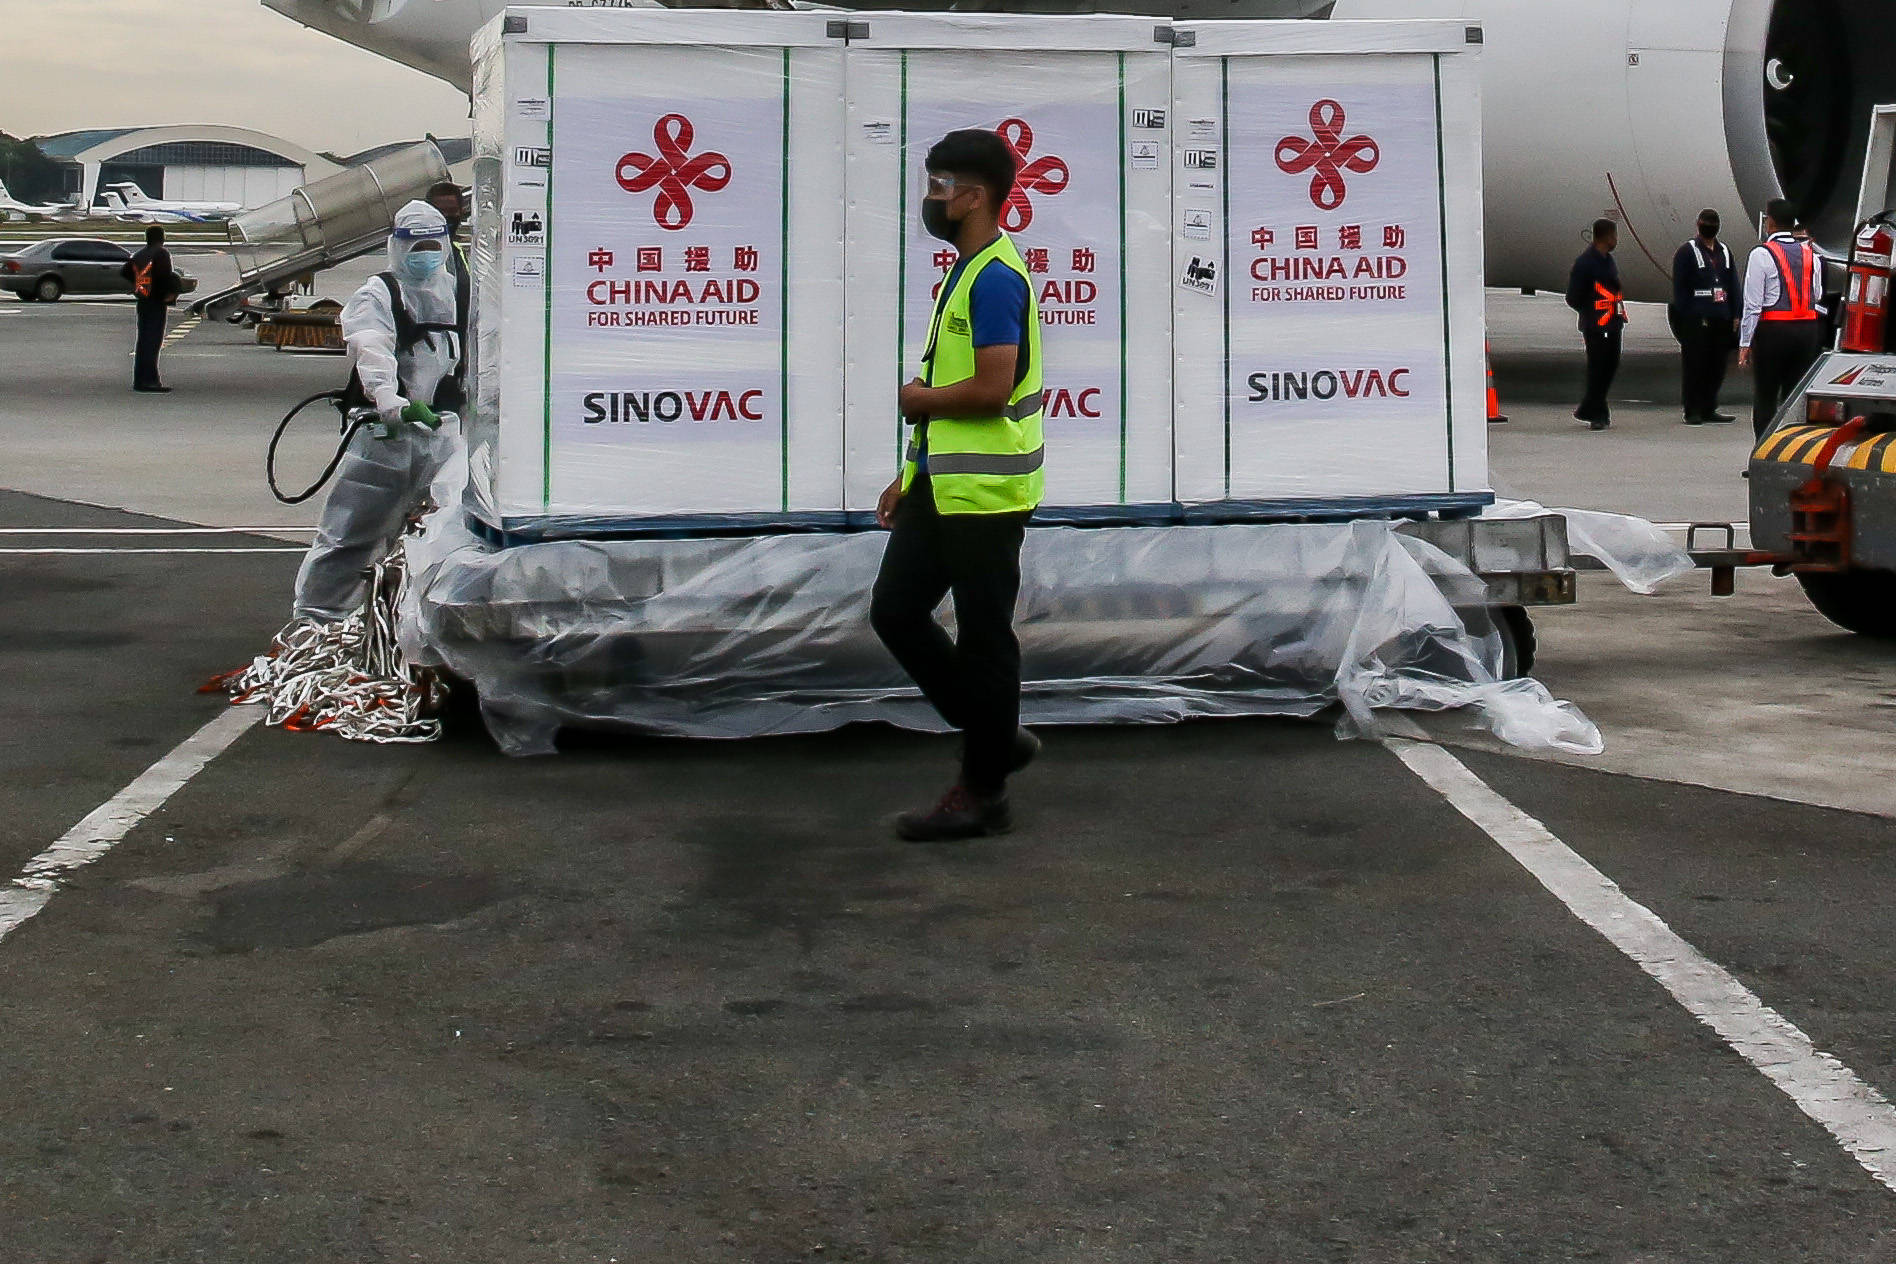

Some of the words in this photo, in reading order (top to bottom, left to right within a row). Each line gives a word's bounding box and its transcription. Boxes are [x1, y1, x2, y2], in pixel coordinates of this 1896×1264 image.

[1251, 224, 1405, 251] 中国援助
[588, 246, 758, 273] 中国援助
[933, 248, 1095, 274] 中援助
[1250, 256, 1347, 281] CHINA
[1352, 255, 1407, 279] AID
[586, 279, 694, 305] CHINA
[699, 278, 761, 304] AID
[1039, 280, 1097, 304] AID
[1252, 287, 1281, 302] FOR
[1285, 287, 1345, 301] SHARED
[1349, 285, 1407, 300] FUTURE
[588, 311, 620, 326] FOR
[624, 310, 691, 326] SHARED
[695, 309, 759, 325] FUTURE
[1247, 368, 1411, 402] SINOVAC
[583, 389, 764, 424] SINOVAC
